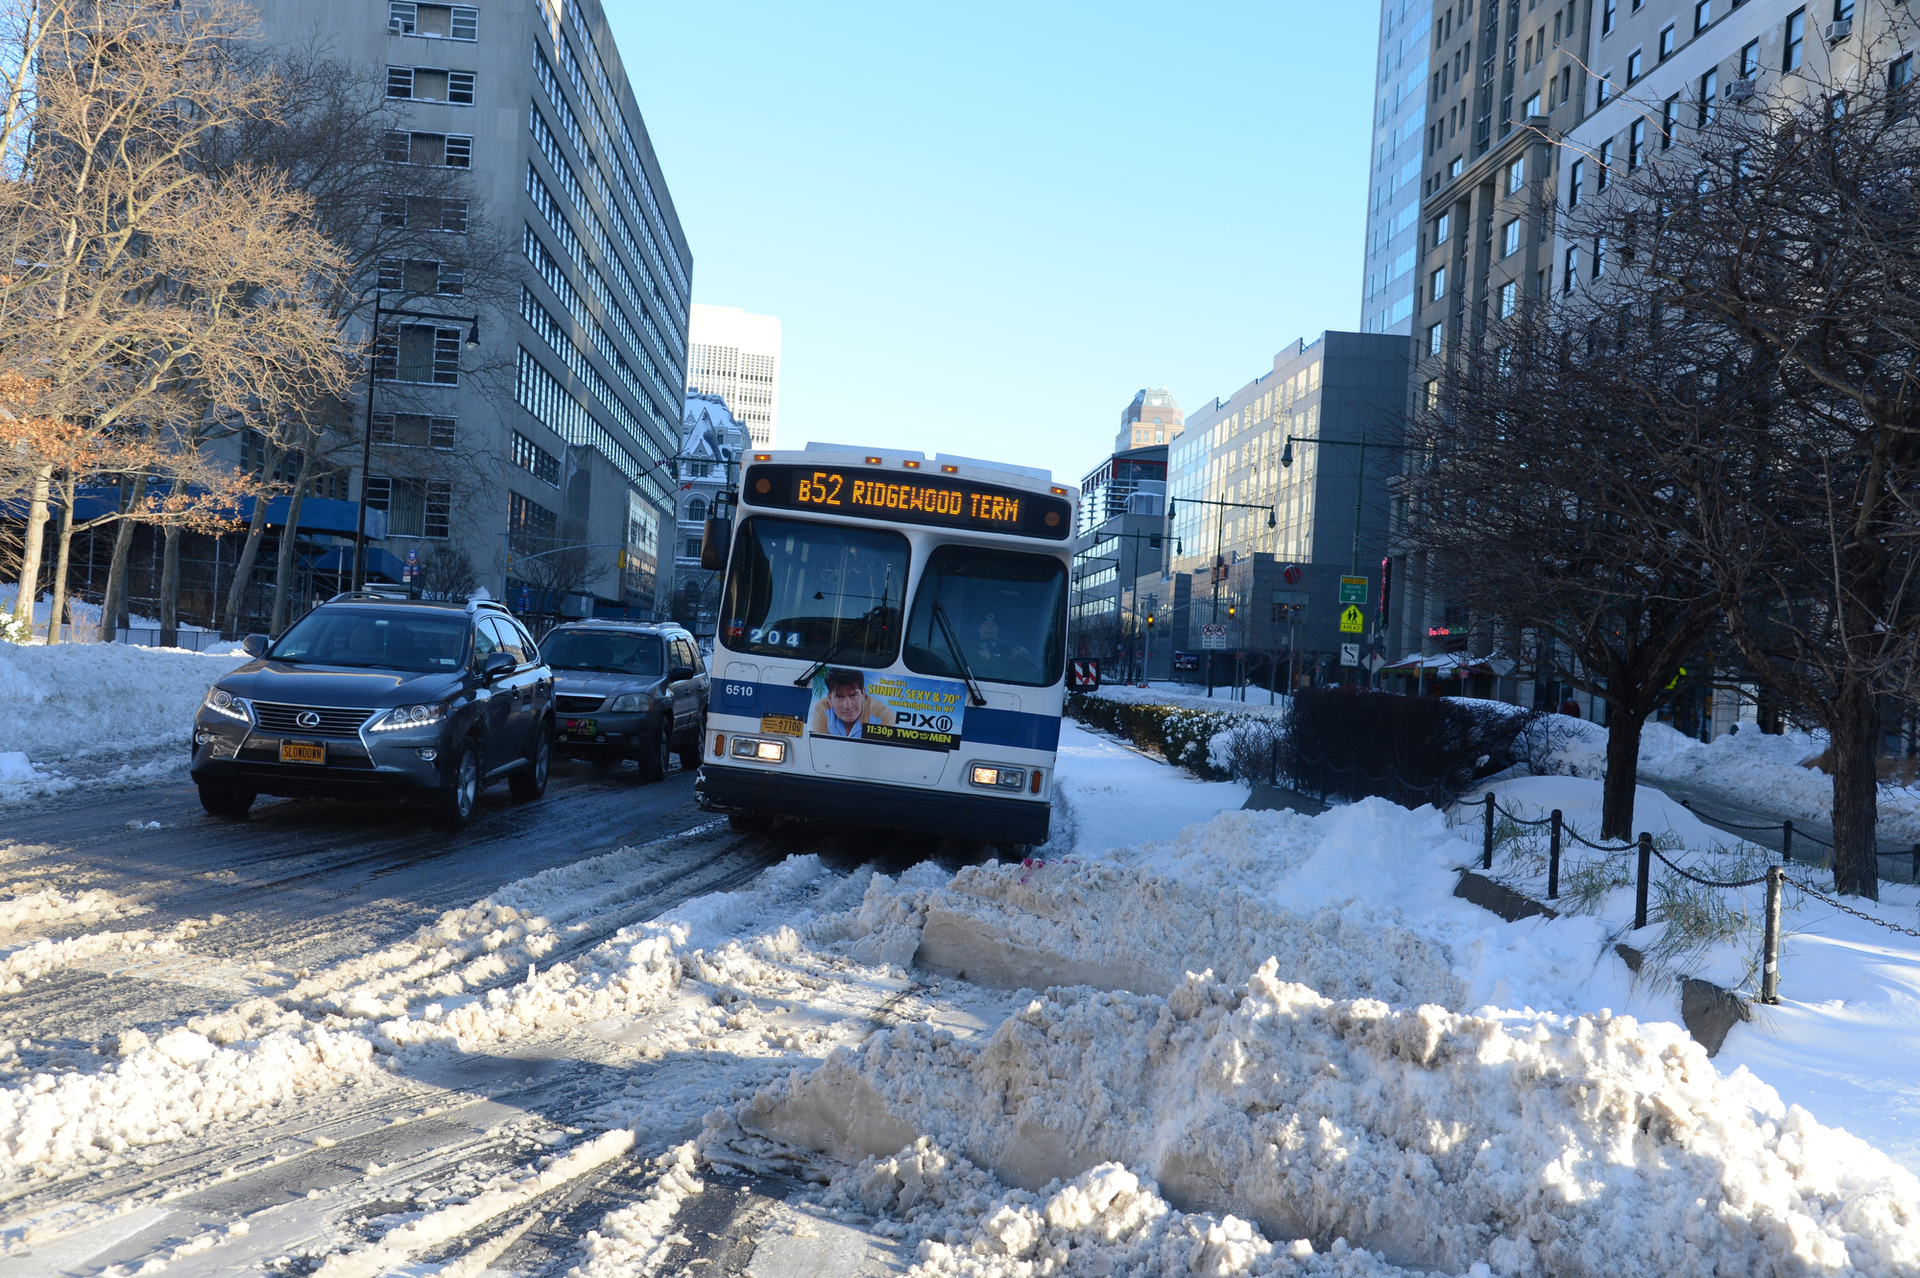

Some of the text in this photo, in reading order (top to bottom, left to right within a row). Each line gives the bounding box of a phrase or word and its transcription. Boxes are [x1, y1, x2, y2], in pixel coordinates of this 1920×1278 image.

[798, 472, 1019, 522] B52 RIDGEWOOD TERM
[880, 678, 895, 686] Now
[726, 684, 753, 696] 6510
[867, 684, 904, 699] SUNNY,
[905, 688, 932, 701] SEXY
[932, 693, 941, 703] &
[888, 700, 933, 711] weeknights
[866, 725, 894, 737] 11:30p
[896, 729, 919, 739] TWO
[929, 733, 952, 743] MEN
[284, 746, 322, 759] SLOWDOWN
